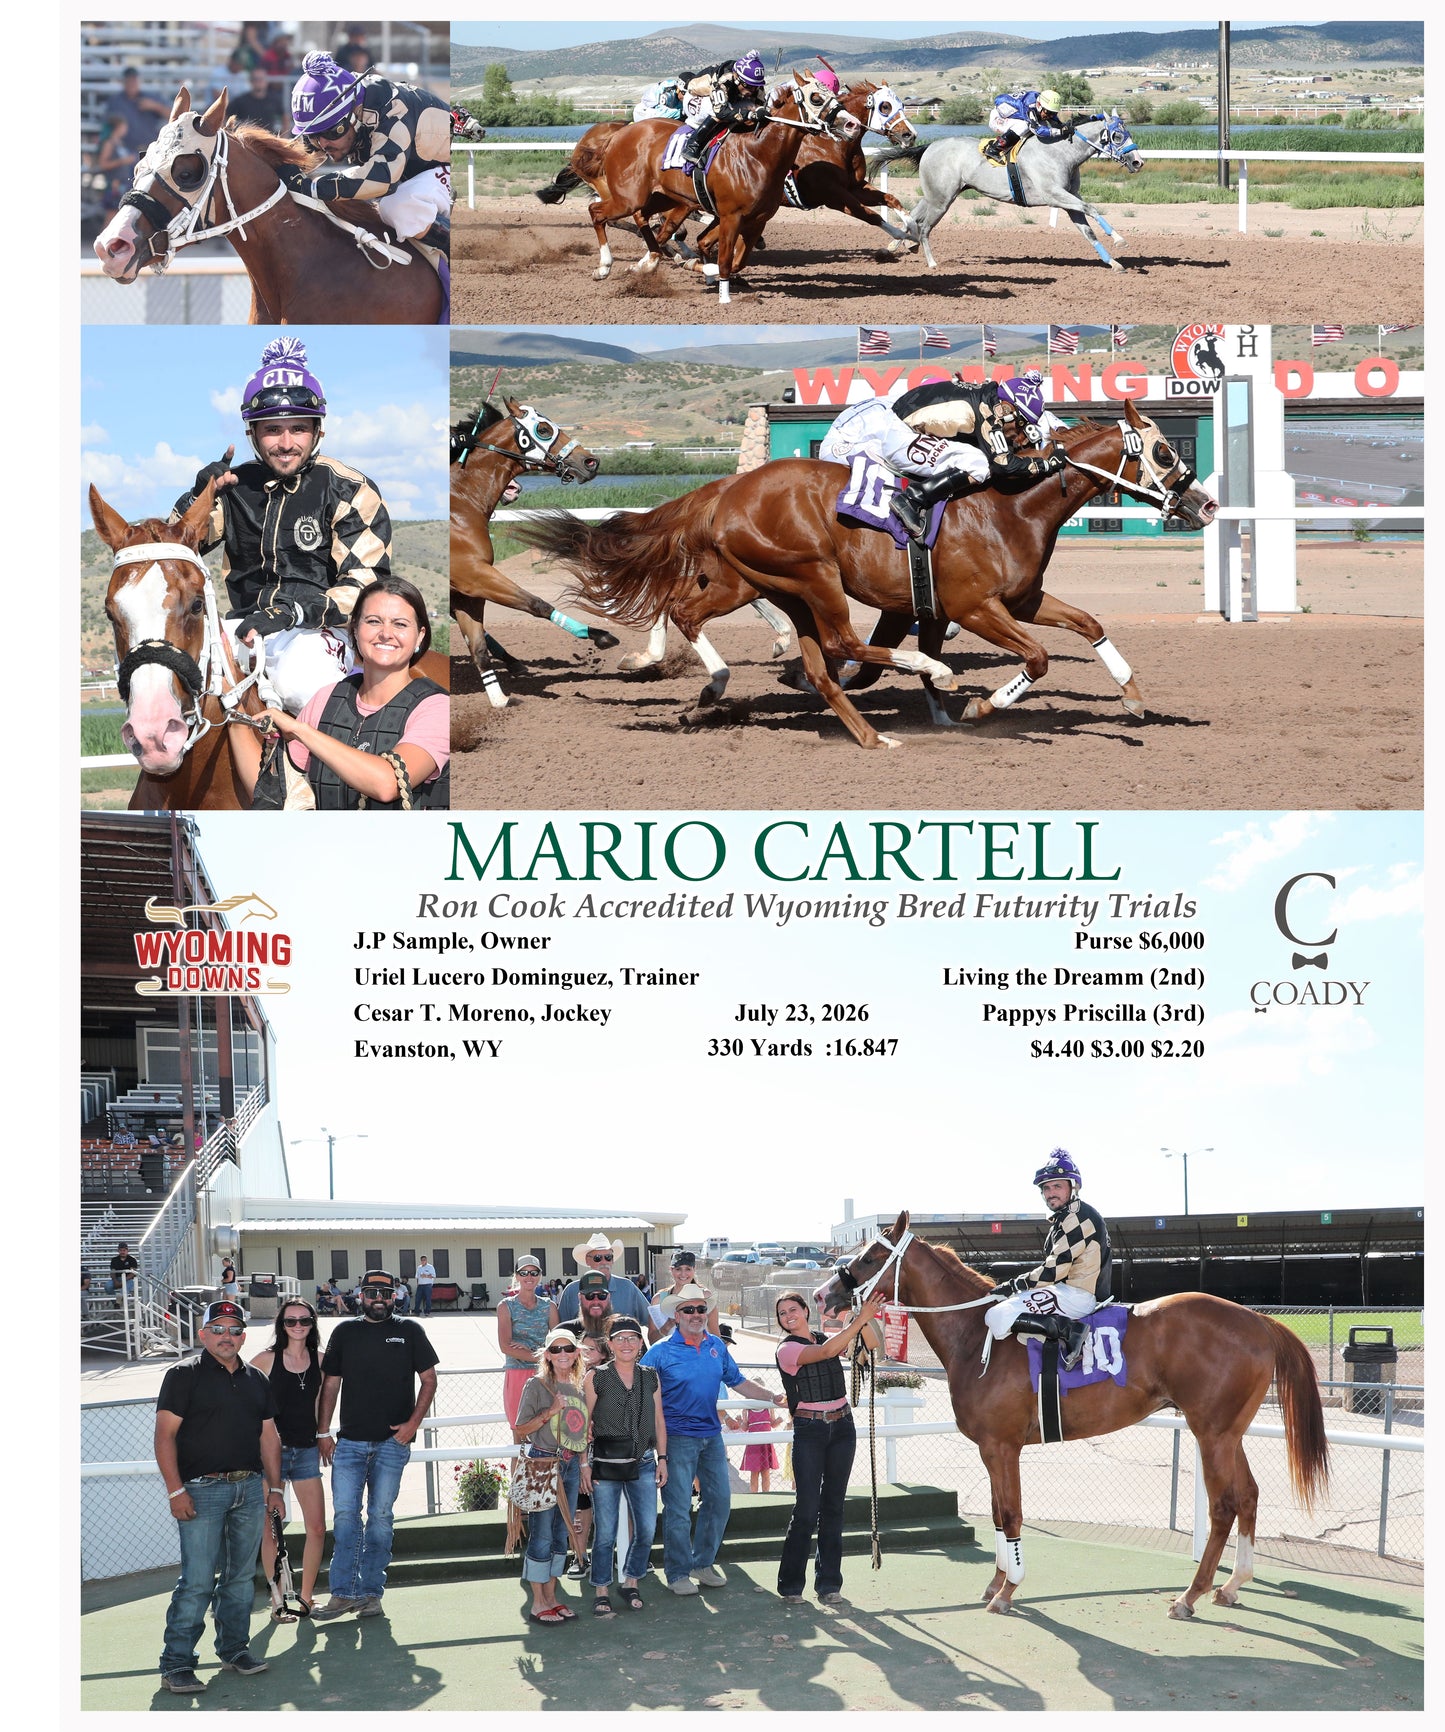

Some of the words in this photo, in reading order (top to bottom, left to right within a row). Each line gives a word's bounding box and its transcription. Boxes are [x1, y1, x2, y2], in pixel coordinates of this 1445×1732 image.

[712, 90, 726, 103] 10
[867, 94, 873, 107] 8
[1101, 129, 1109, 142] 4
[263, 368, 304, 388] CTM
[519, 430, 530, 448] 6
[989, 430, 1009, 454] 10
[1025, 424, 1040, 440] 8
[1124, 432, 1142, 453] 10
[927, 440, 949, 467] Jockey
[843, 456, 895, 519] 10
[1082, 1326, 1123, 1376] 10
